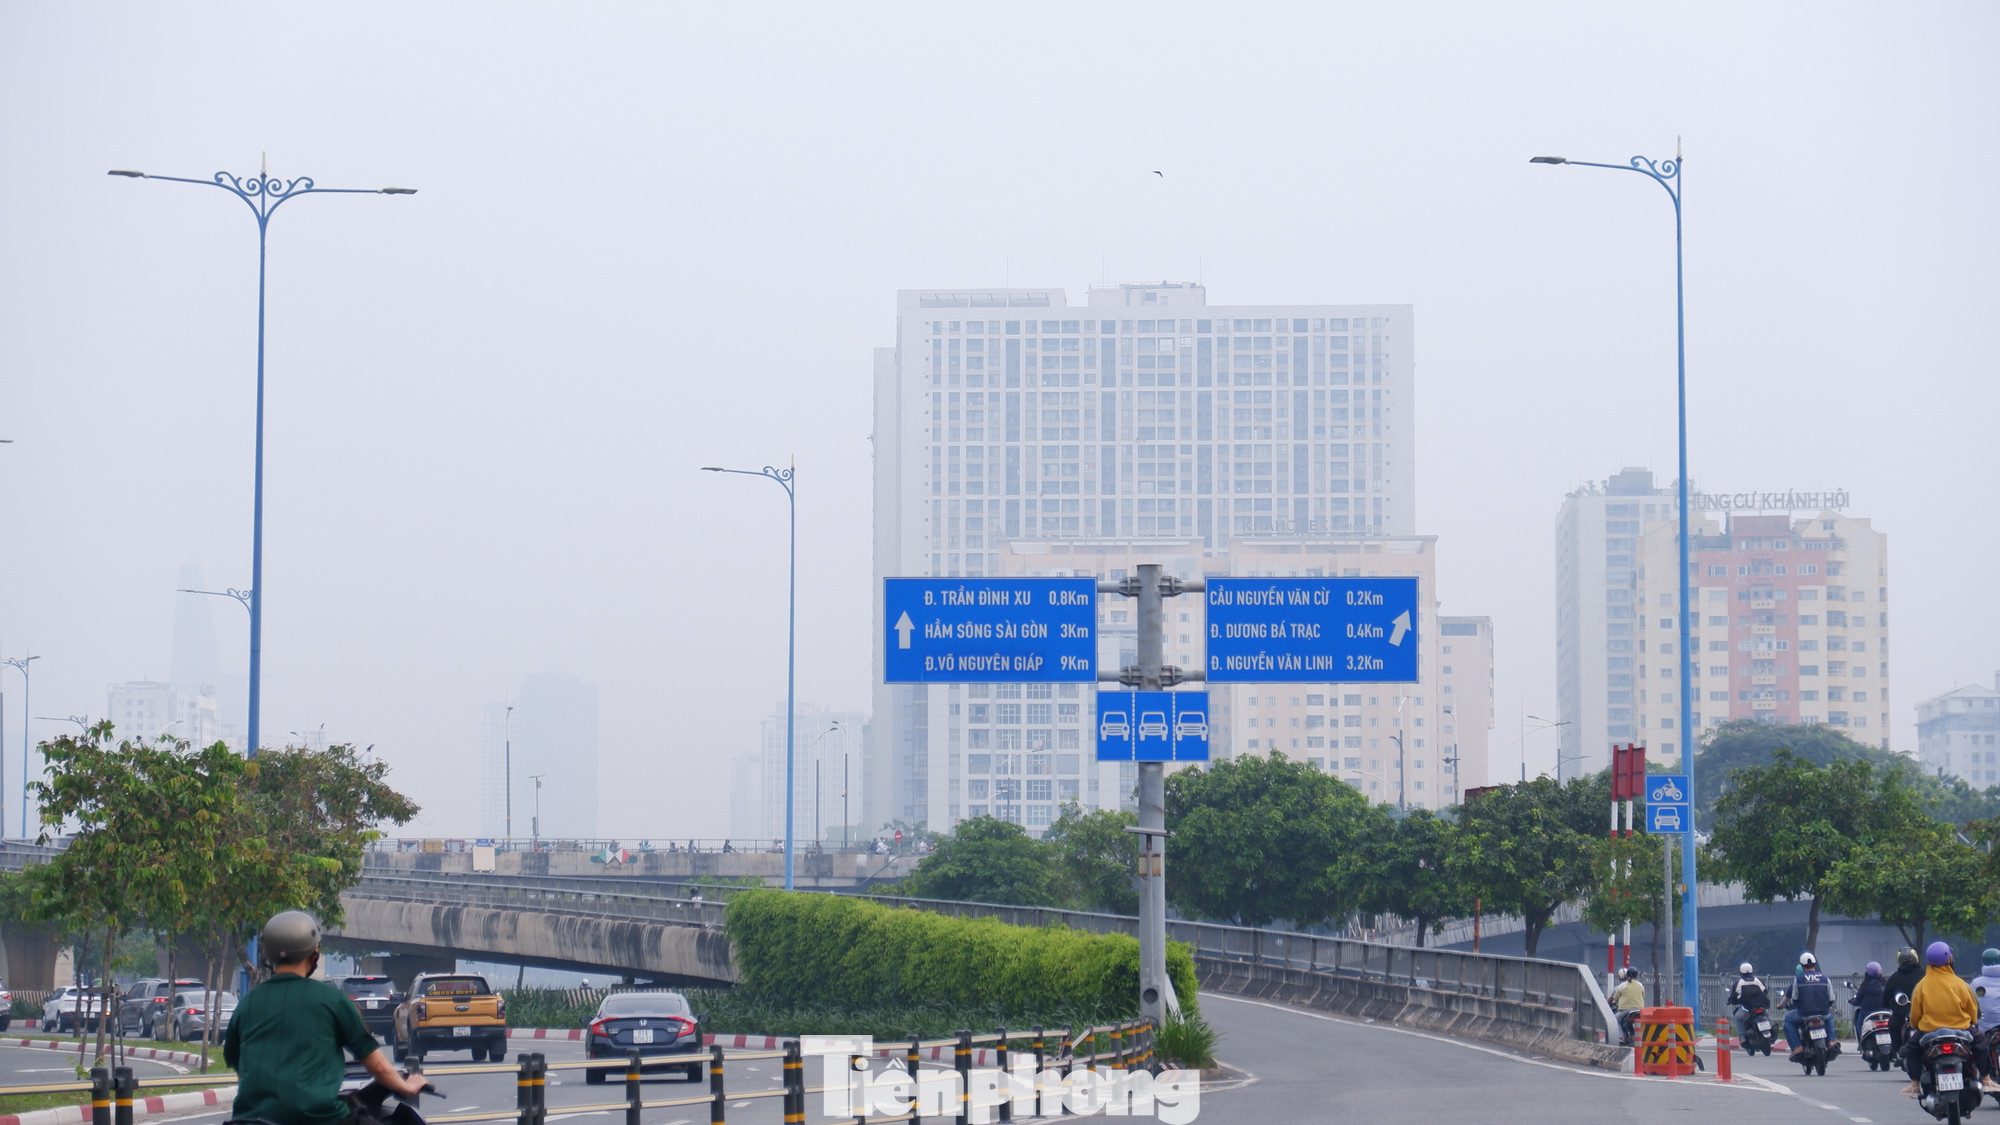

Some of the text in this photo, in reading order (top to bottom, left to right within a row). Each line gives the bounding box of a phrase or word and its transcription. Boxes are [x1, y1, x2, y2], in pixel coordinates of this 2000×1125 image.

[1733, 490, 1758, 509] CƯ
[1761, 488, 1819, 509] KHÁNH
[1823, 487, 1850, 512] HỘI
[924, 585, 1089, 607] Đ. TRẦN ĐÌNH XU 0,8Km
[1209, 584, 1384, 607] CẦU NGUYỄN VĂN CỪ 0,2Km
[924, 618, 1089, 638] HẦM SÔNG SÀI GÒN 3Km
[1210, 620, 1384, 640] Đ. DƯƠNG BÁ TRẠC 0,4Km
[924, 653, 1089, 671] Đ.VÕ NGUYÊN GIÁP 9Km
[1211, 651, 1384, 671] Đ. NGUYỄN VĂN LINH 3,2Km
